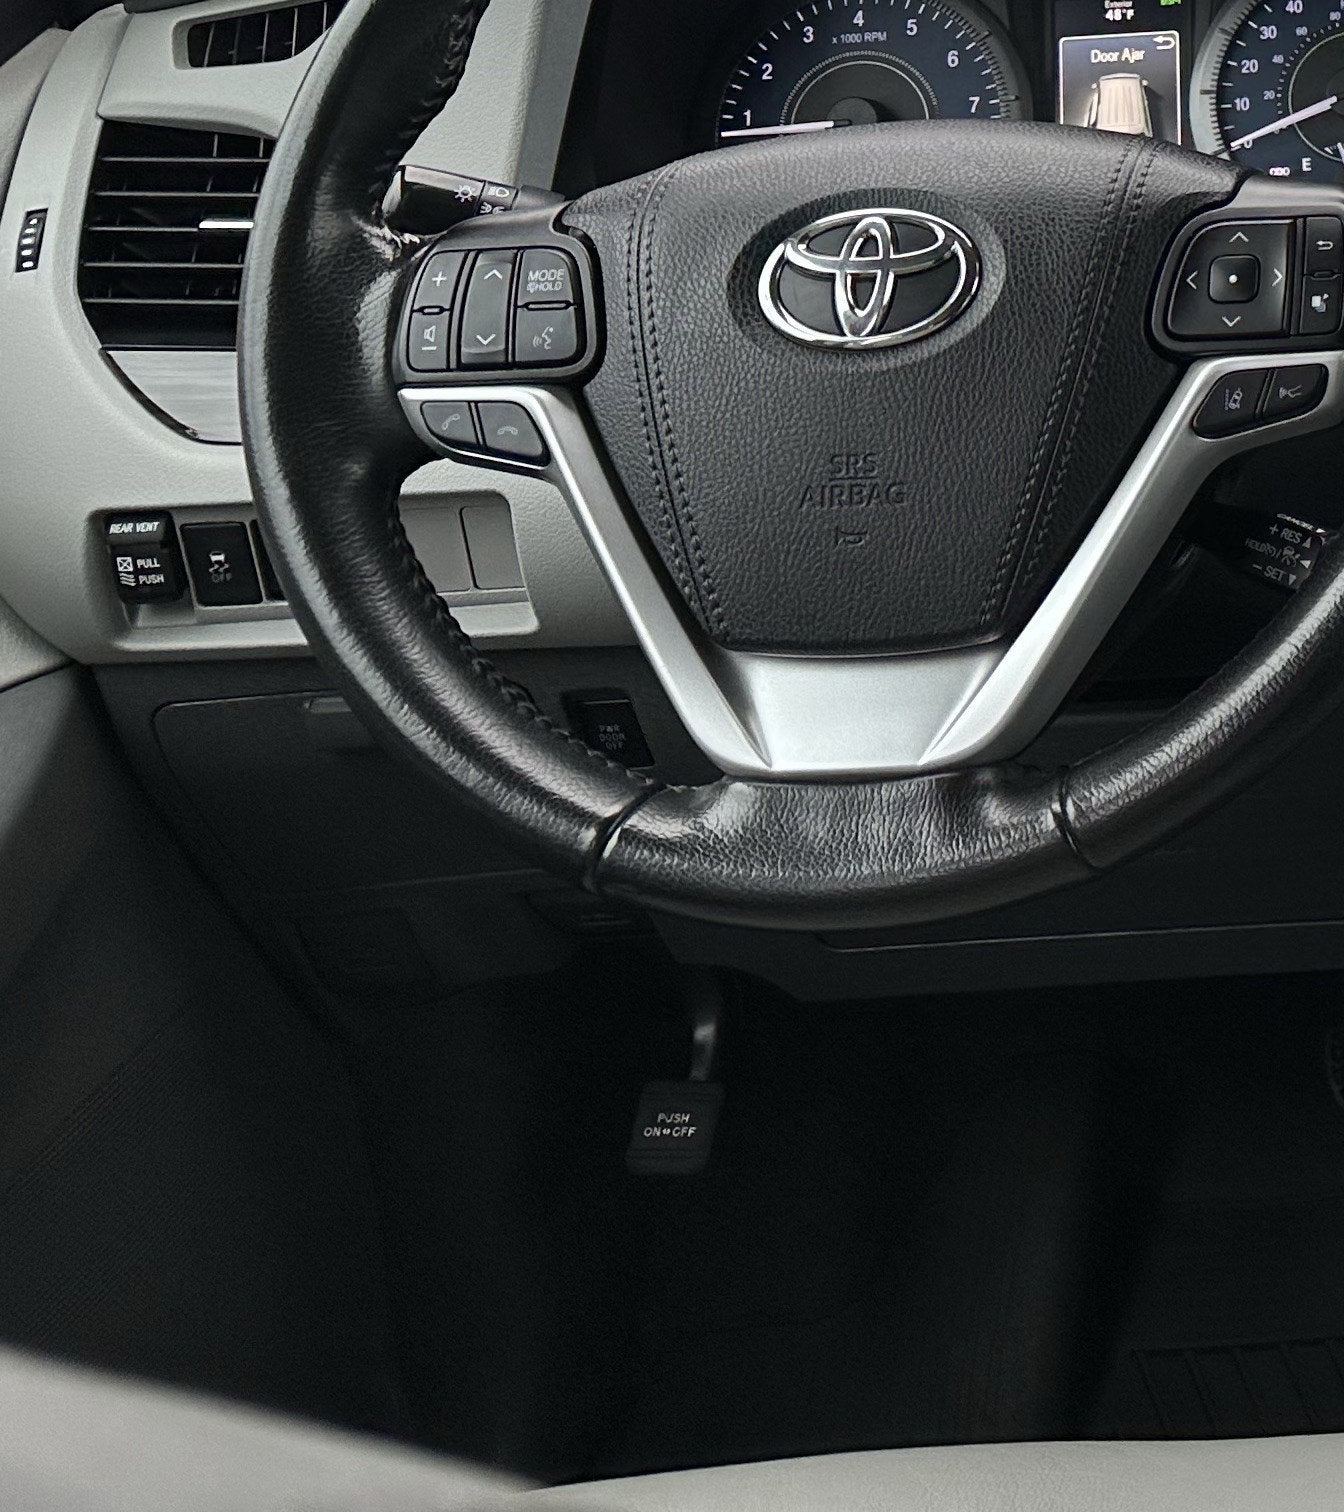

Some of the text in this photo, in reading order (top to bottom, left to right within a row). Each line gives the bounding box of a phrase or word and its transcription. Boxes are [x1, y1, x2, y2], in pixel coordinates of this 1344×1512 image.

[1285, 0, 1304, 14] 40
[852, 9, 864, 27] 4
[802, 25, 814, 43] 3
[905, 18, 918, 36] 5
[1259, 25, 1278, 40] 30
[840, 32, 863, 43] 1000
[863, 31, 887, 42] RPM
[947, 49, 959, 68] 6
[1090, 48, 1146, 64] Door Ajar
[761, 62, 774, 80] 2
[1240, 58, 1259, 74] 20
[1262, 89, 1276, 101] 20
[968, 96, 981, 114] 7
[1234, 97, 1250, 111] 10
[742, 108, 752, 127] 1
[1302, 157, 1311, 172] E
[527, 268, 565, 281] MODE
[829, 452, 878, 476] SRS
[799, 481, 907, 509] AIRBAG
[109, 521, 160, 535] REAR VENT
[1280, 527, 1303, 544] RES
[136, 558, 160, 569] PULL
[138, 574, 164, 585] PUSH
[1263, 565, 1287, 582] SET
[657, 1113, 690, 1124] PUSH
[643, 1126, 697, 1138] ON OFF
